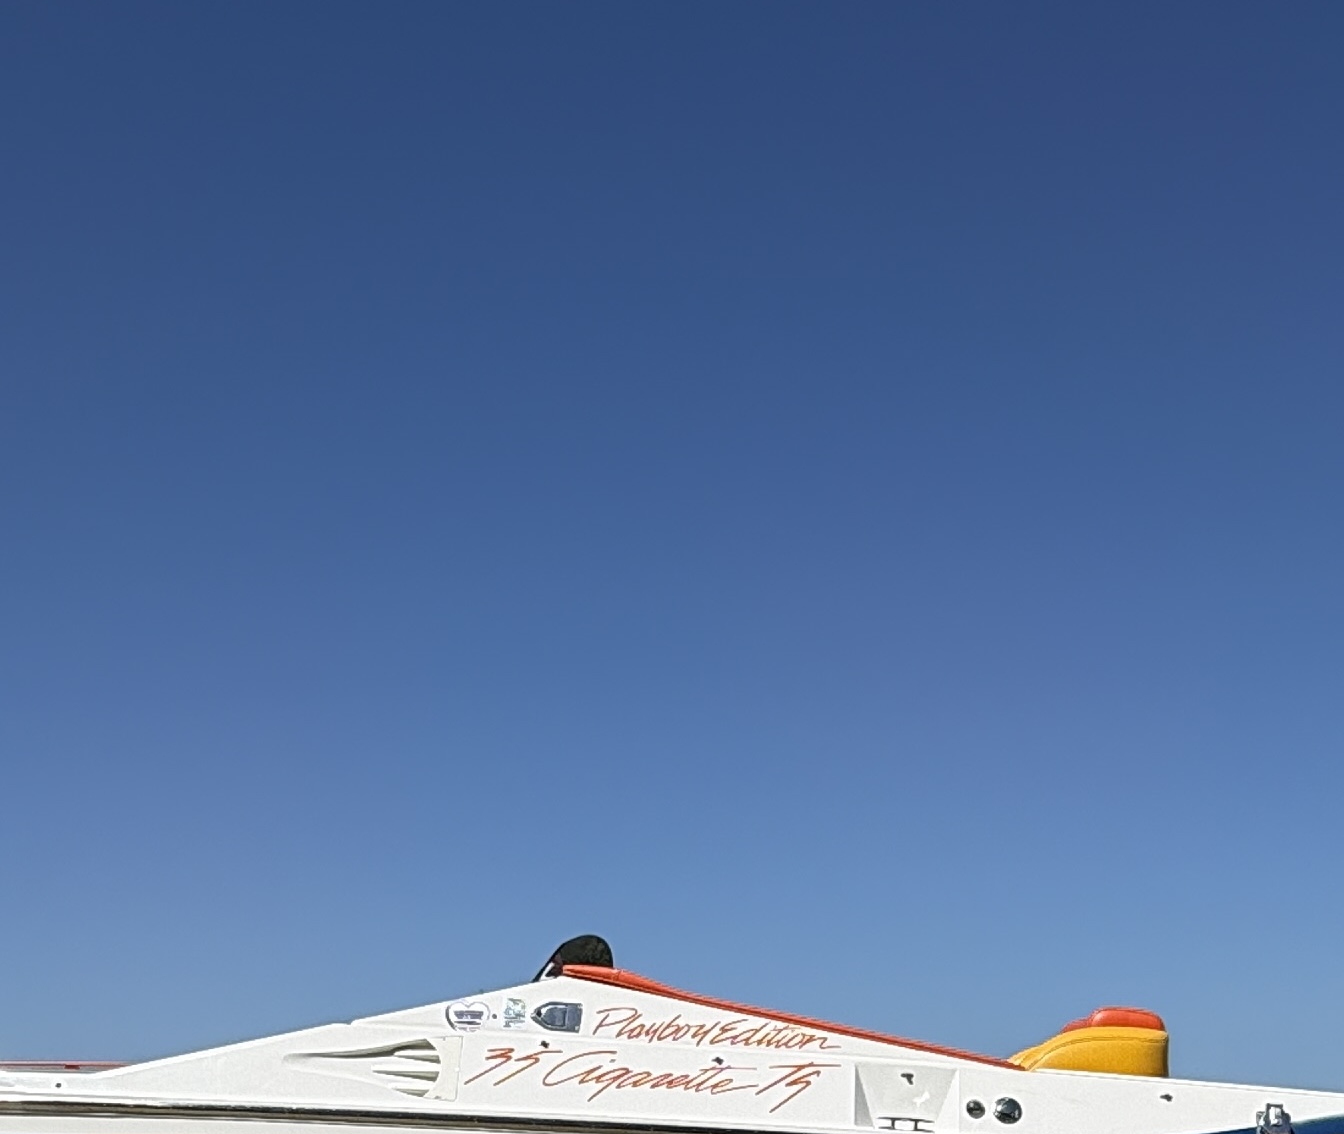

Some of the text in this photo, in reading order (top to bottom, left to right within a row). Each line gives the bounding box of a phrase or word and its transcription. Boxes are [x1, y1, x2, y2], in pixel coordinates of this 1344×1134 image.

[709, 1018, 841, 1050] Edition
[464, 1048, 563, 1086] 35
[543, 1051, 760, 1102] Cigarette
